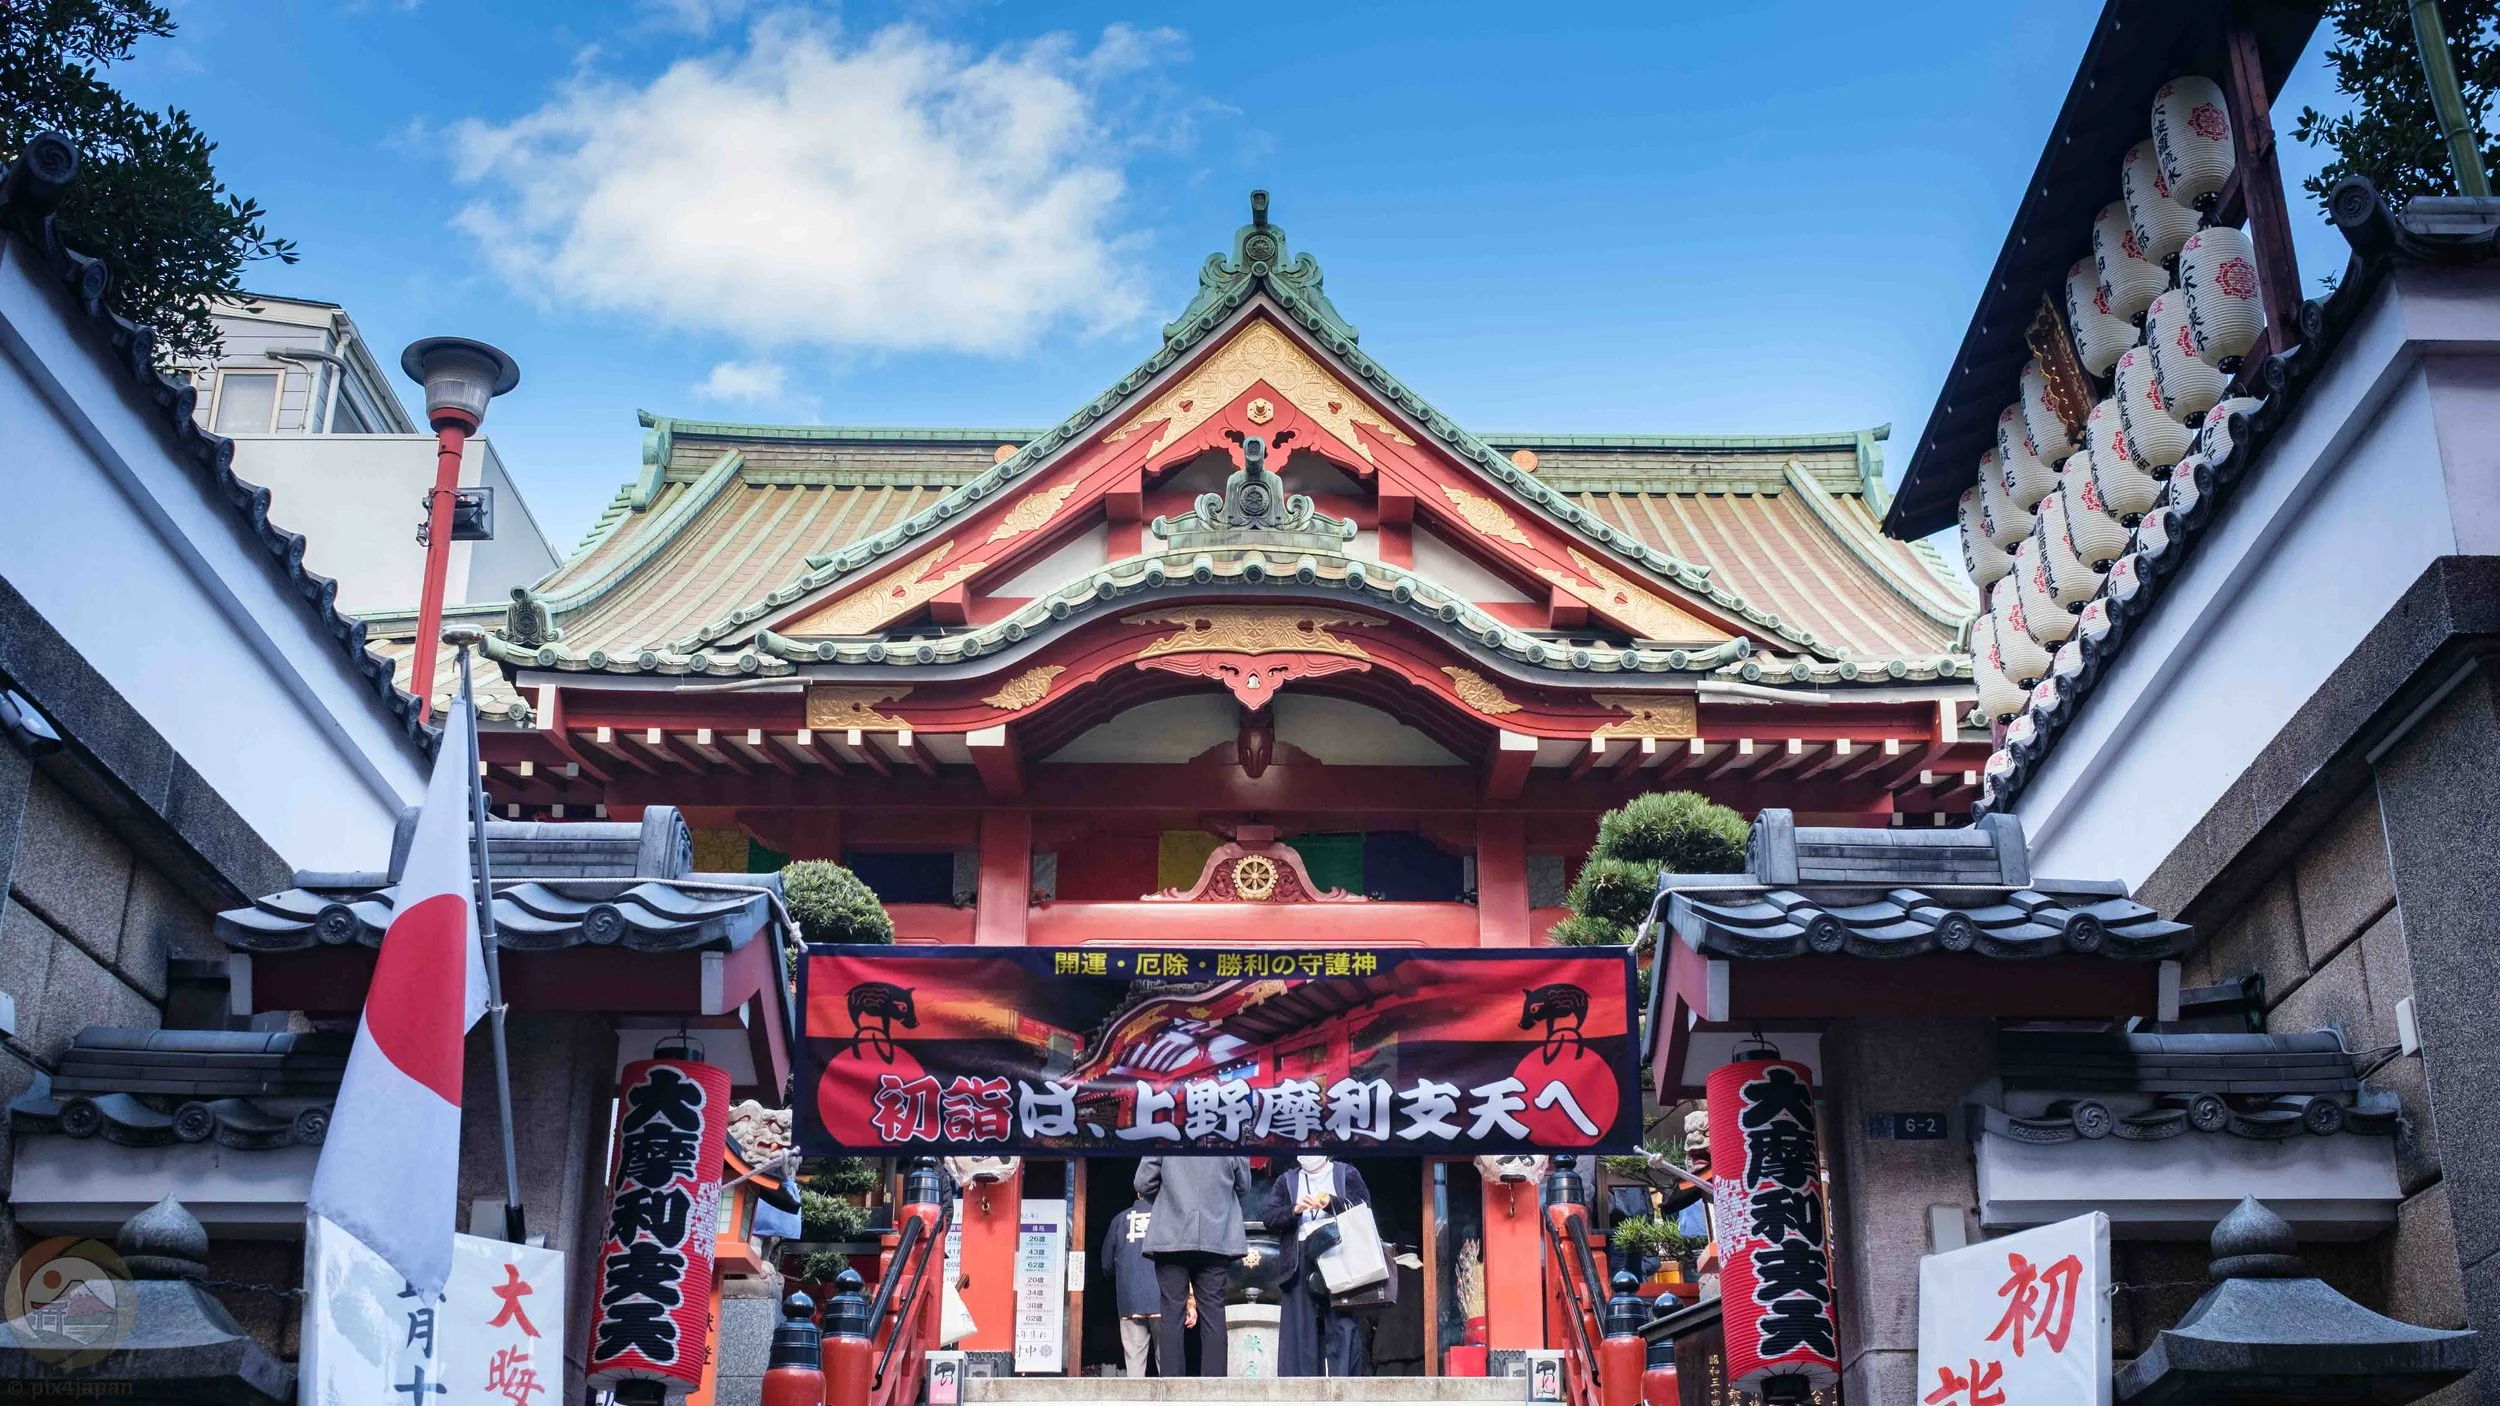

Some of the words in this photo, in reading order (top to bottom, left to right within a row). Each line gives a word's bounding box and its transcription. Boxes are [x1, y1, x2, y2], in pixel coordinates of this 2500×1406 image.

[1054, 951, 1377, 977] 開運・厄除・勝利の守護神
[873, 1074, 1599, 1143] 初詣は、上野摩利支天へ
[1905, 1118, 1937, 1133] 6-2
[594, 1066, 705, 1363] 大摩利支天
[1028, 1235, 1046, 1243] 26歳
[1028, 1248, 1045, 1256] 43歳
[1027, 1261, 1045, 1269] 62歳
[1026, 1289, 1044, 1297] 34歳
[394, 1280, 448, 1406] 月十
